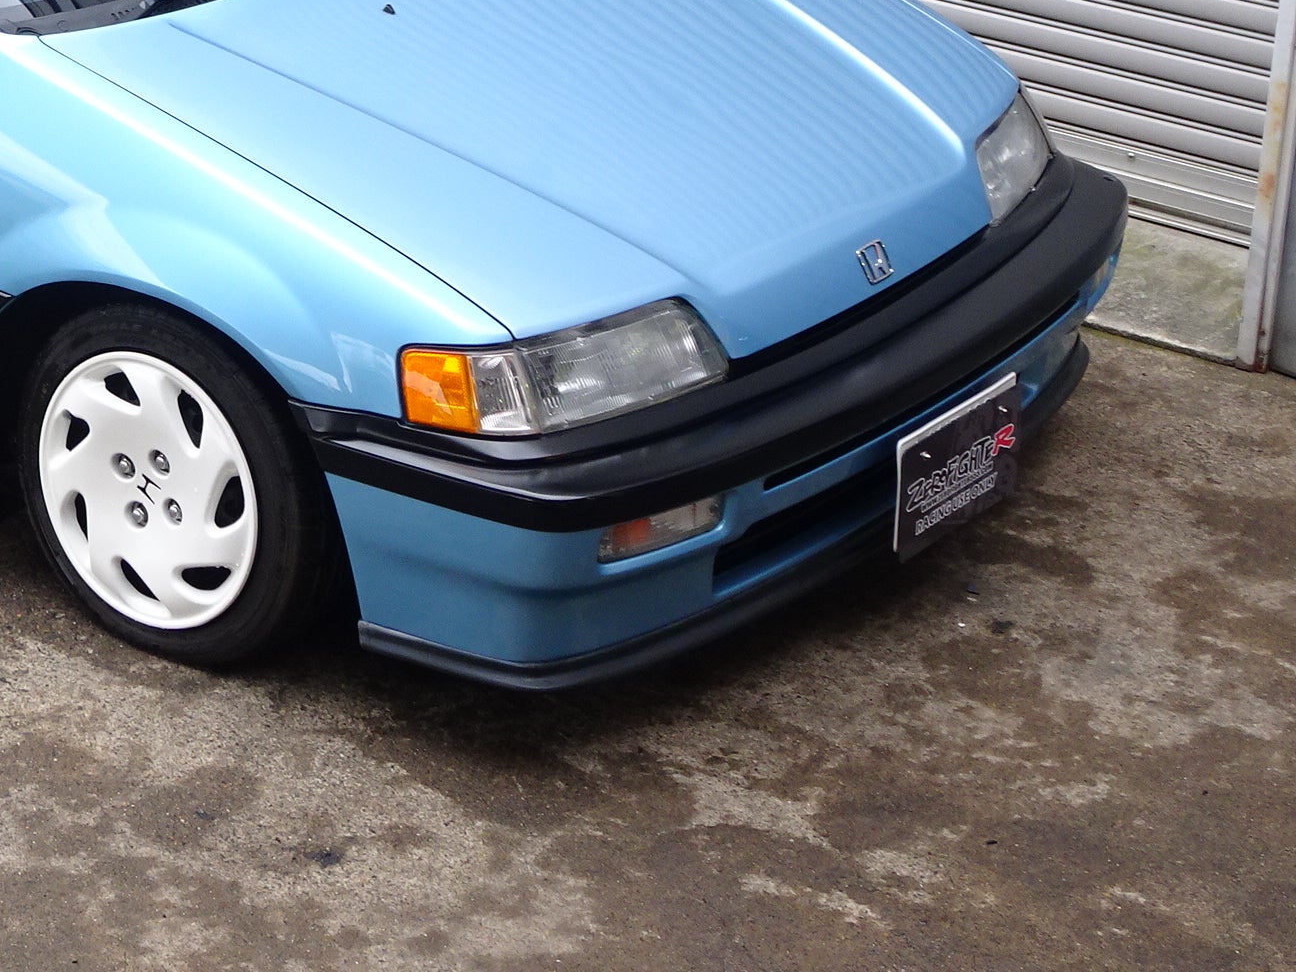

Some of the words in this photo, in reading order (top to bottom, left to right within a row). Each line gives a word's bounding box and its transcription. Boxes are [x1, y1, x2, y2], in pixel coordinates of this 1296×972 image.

[915, 500, 952, 536] RACING
[952, 487, 971, 512] USE
[970, 471, 999, 500] ONLY
